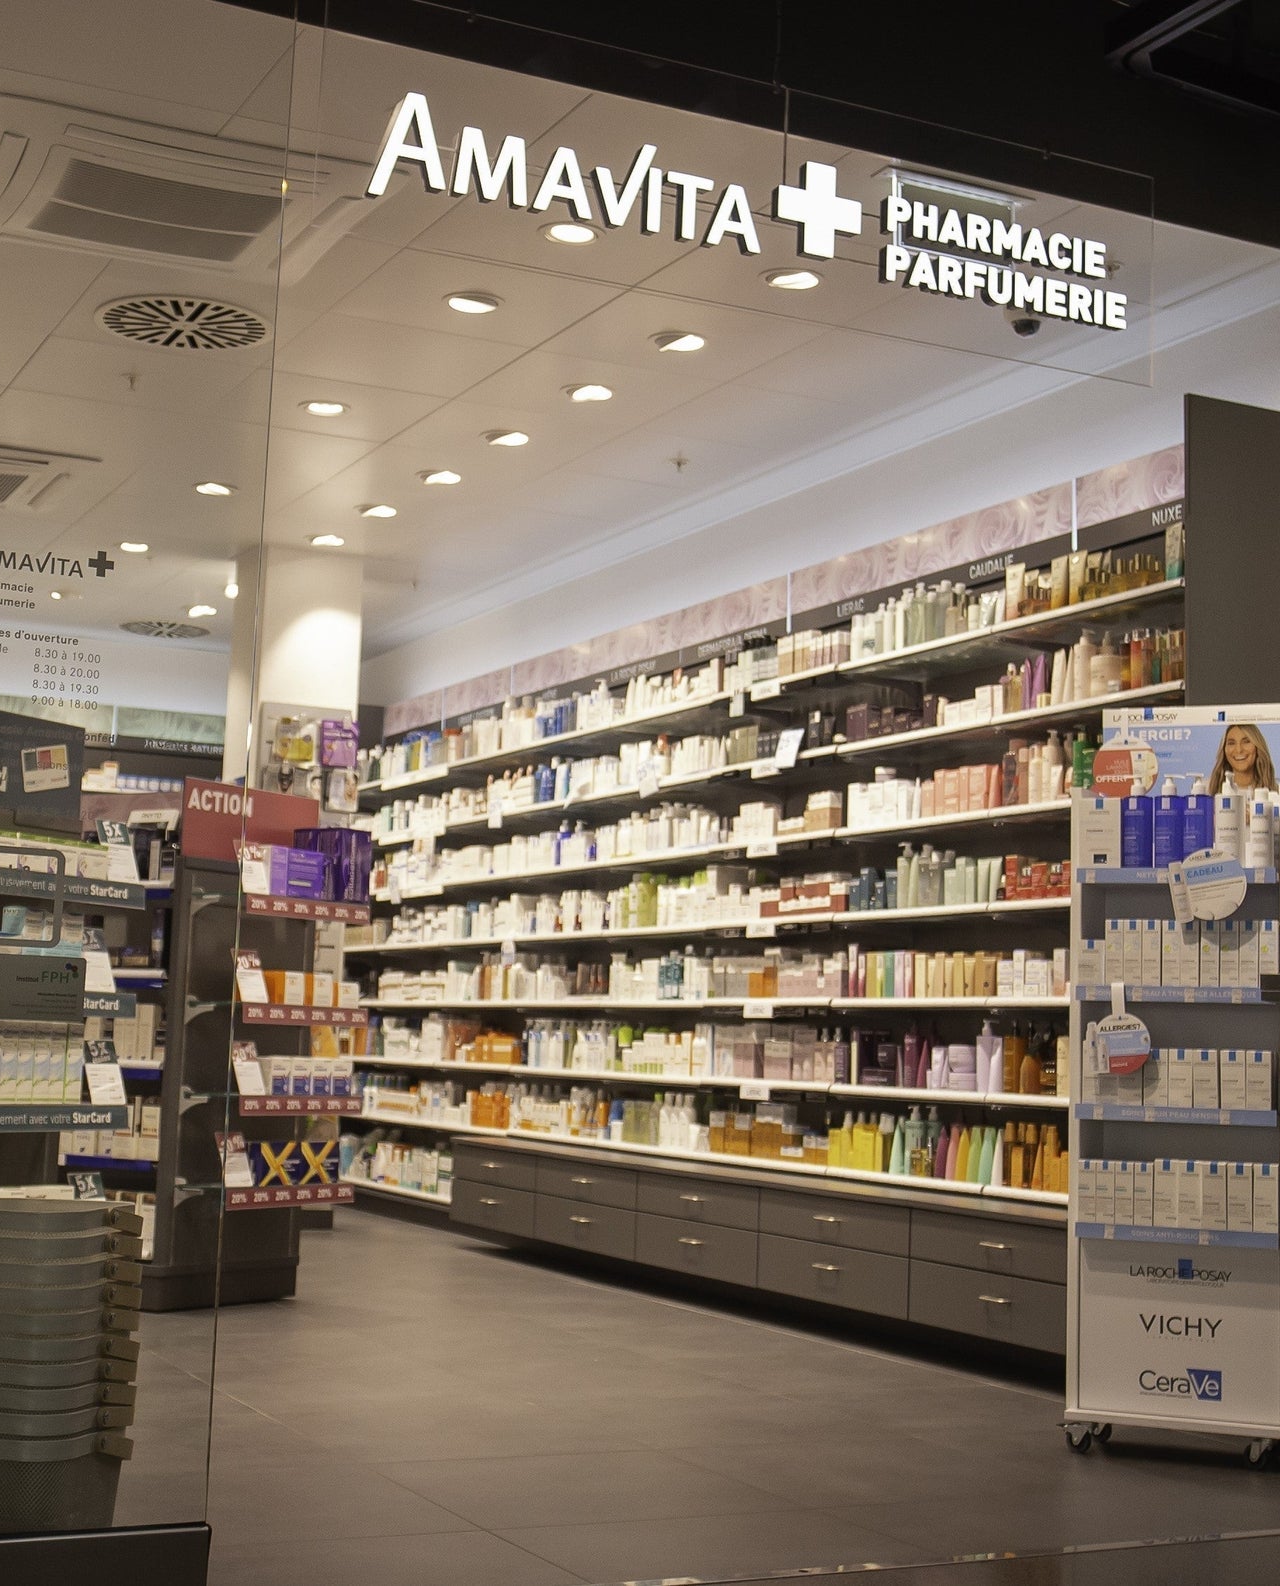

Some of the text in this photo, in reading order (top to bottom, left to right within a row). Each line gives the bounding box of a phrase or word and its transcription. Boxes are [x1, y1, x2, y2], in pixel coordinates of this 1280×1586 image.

[367, 91, 762, 256] AMAVITA
[886, 194, 1108, 281] PHARMACIE
[884, 243, 1128, 332] PARFUMERIE
[1151, 503, 1183, 528] NUXE
[969, 553, 1014, 580] CAUDALIE
[836, 598, 865, 619] LIERAC
[14, 629, 79, 647] d'ouverture
[34, 647, 58, 660] 8.30
[61, 650, 67, 661] à
[72, 652, 101, 664] 19.00
[33, 663, 57, 675] 8.30
[60, 665, 66, 676] à
[70, 667, 100, 680] 20.00
[32, 679, 56, 691] 8.30
[59, 681, 65, 692] à
[70, 683, 99, 695] 19.30
[31, 695, 55, 707] 9.00
[58, 697, 64, 708] à
[69, 699, 98, 711] 18.00
[187, 786, 254, 818] ACTION
[1186, 865, 1224, 879] CADEAU
[68, 882, 89, 896] votre
[89, 883, 129, 900] StarCard
[41, 970, 70, 985] FPH
[247, 1007, 366, 1023] 20% 20% 20% 20% 20% 20%
[29, 1114, 49, 1125] avec
[49, 1113, 70, 1125] votre
[72, 1111, 113, 1125] StarCard
[1129, 1265, 1146, 1277] LA
[1191, 1269, 1233, 1283] POSAY
[1139, 1313, 1224, 1339] VICHY
[1138, 1369, 1221, 1399] CeraVe
